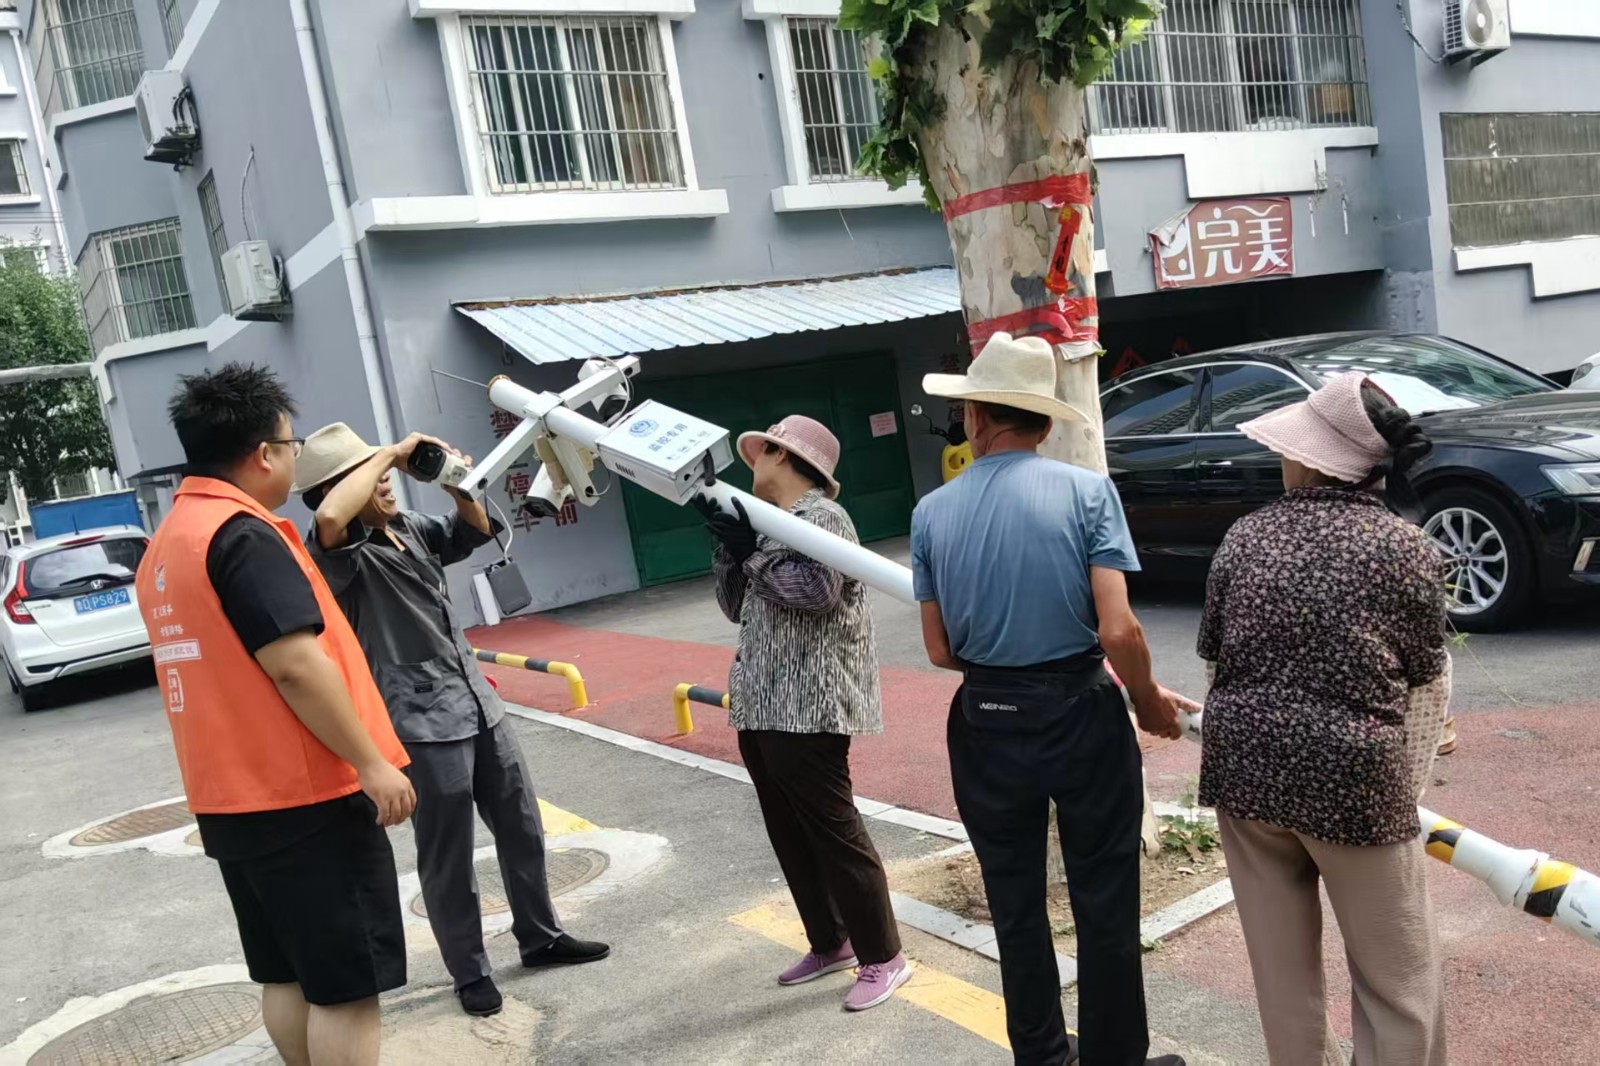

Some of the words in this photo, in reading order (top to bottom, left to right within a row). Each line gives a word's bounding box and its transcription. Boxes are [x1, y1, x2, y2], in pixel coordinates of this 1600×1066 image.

[1197, 204, 1288, 278] 完美
[648, 422, 688, 452] 监控专用
